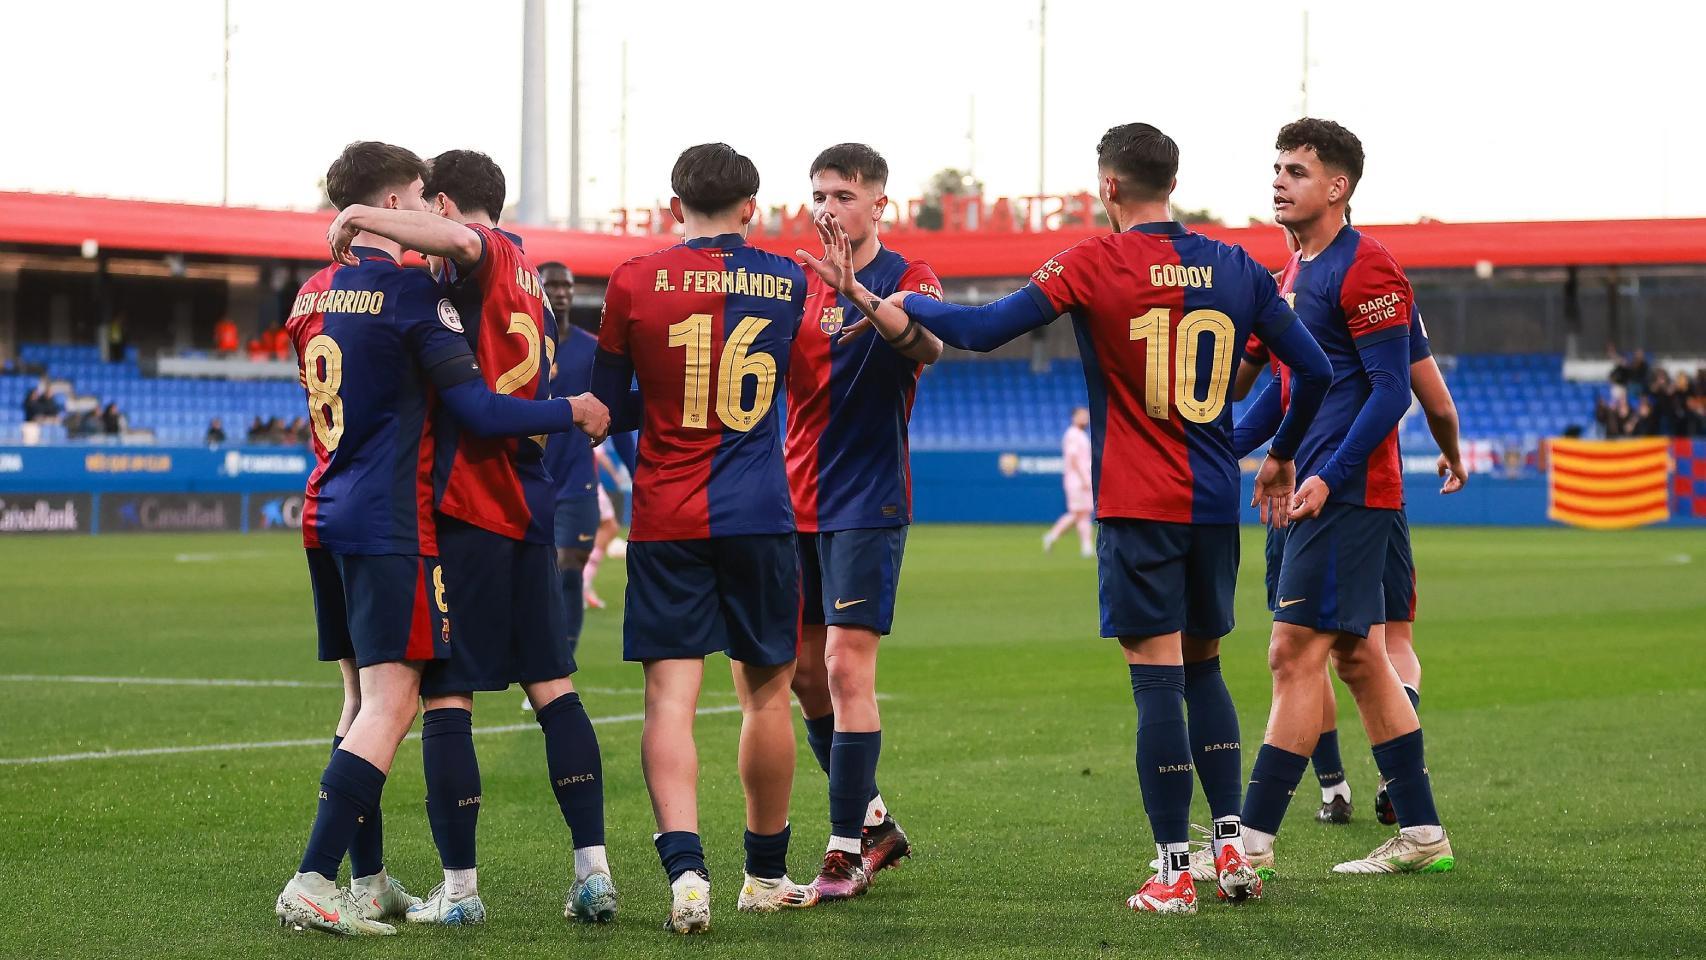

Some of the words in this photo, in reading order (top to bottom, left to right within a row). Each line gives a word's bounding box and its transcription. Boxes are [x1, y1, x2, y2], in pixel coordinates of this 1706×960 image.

[315, 290, 384, 315] GARRIDO
[655, 269, 675, 291] A.
[683, 268, 792, 301] FERNÁNDEZ
[1150, 264, 1213, 288] GODOY
[304, 334, 344, 452] 8
[668, 313, 777, 432] 16
[1129, 308, 1235, 423] 10
